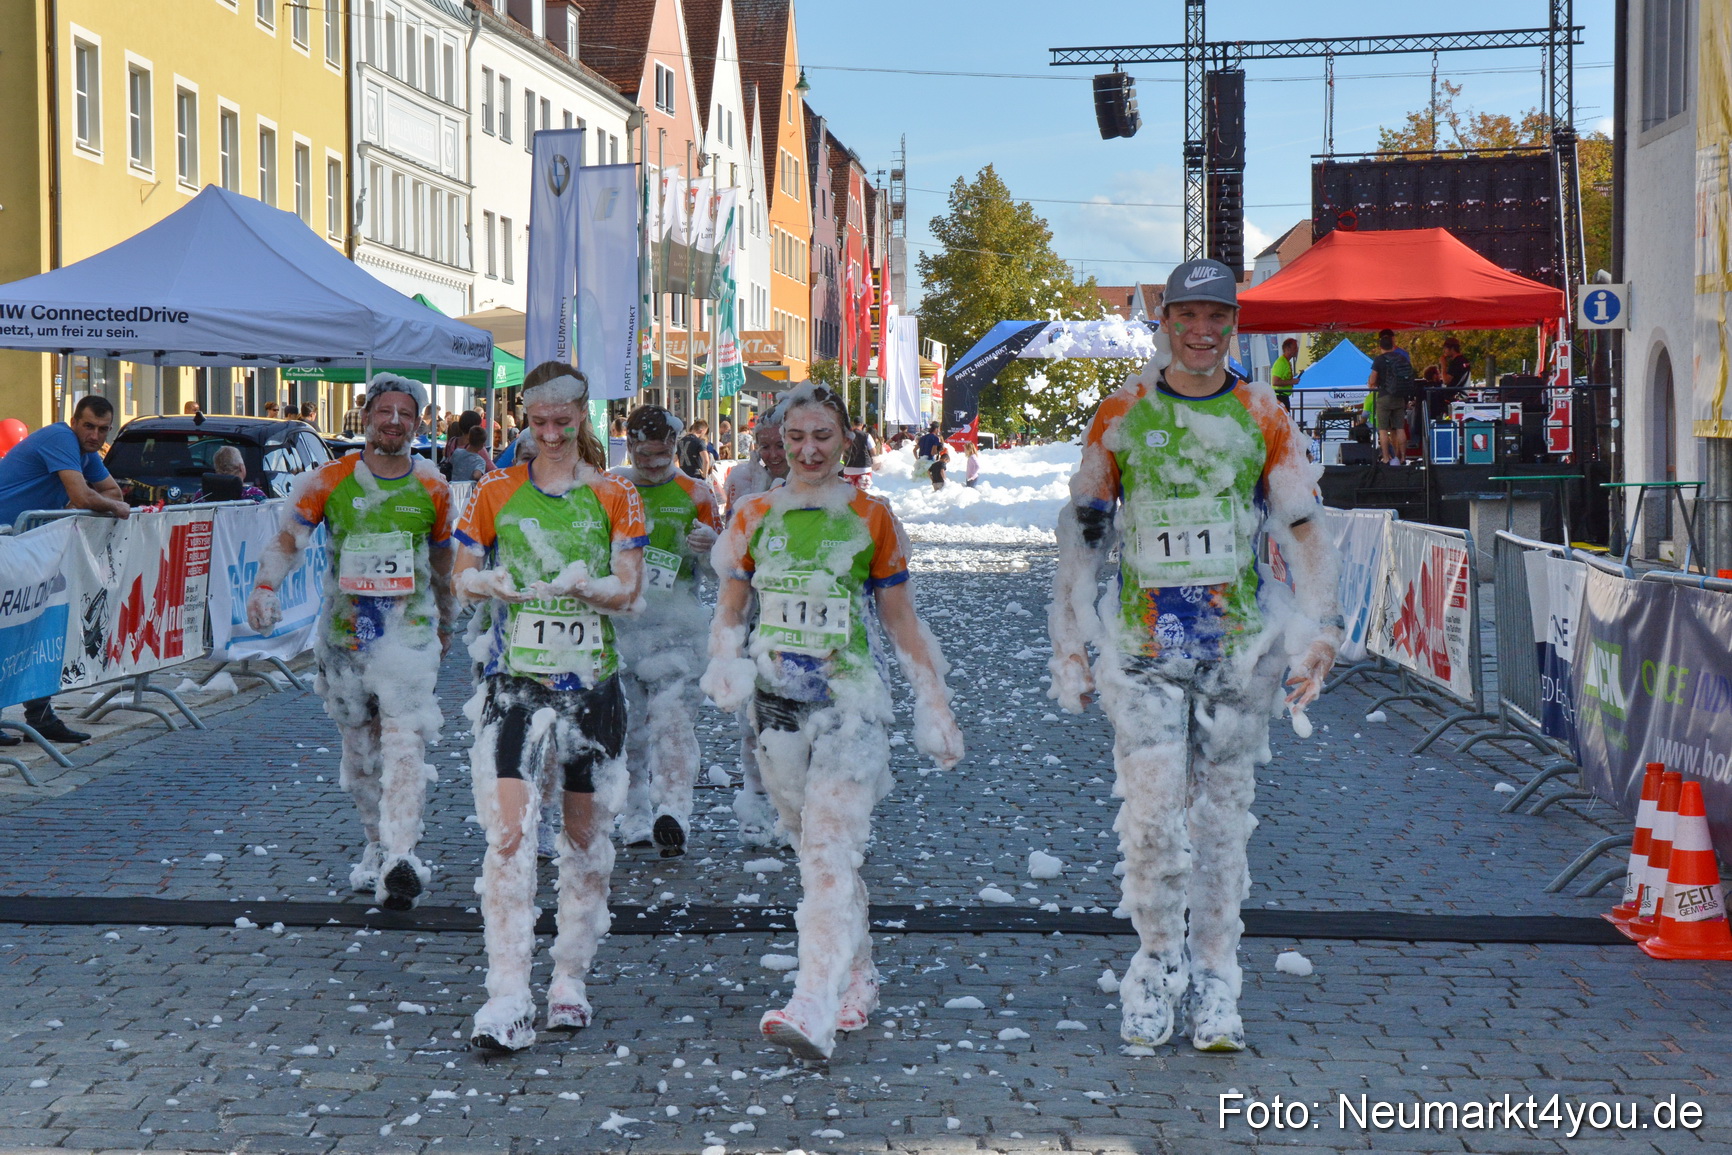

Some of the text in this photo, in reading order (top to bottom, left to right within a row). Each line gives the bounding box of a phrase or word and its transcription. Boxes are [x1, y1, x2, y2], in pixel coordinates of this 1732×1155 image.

[1191, 266, 1218, 279] NIKE
[0, 304, 190, 324] W ConnectedDrive
[0, 324, 139, 339] etzt, um frei zu sein.
[624, 305, 636, 391] PARTL NEUMARKT
[954, 344, 1009, 381] PARTL NEUMARKT
[1156, 529, 1212, 557] 111
[1675, 885, 1714, 909] ZEIT
